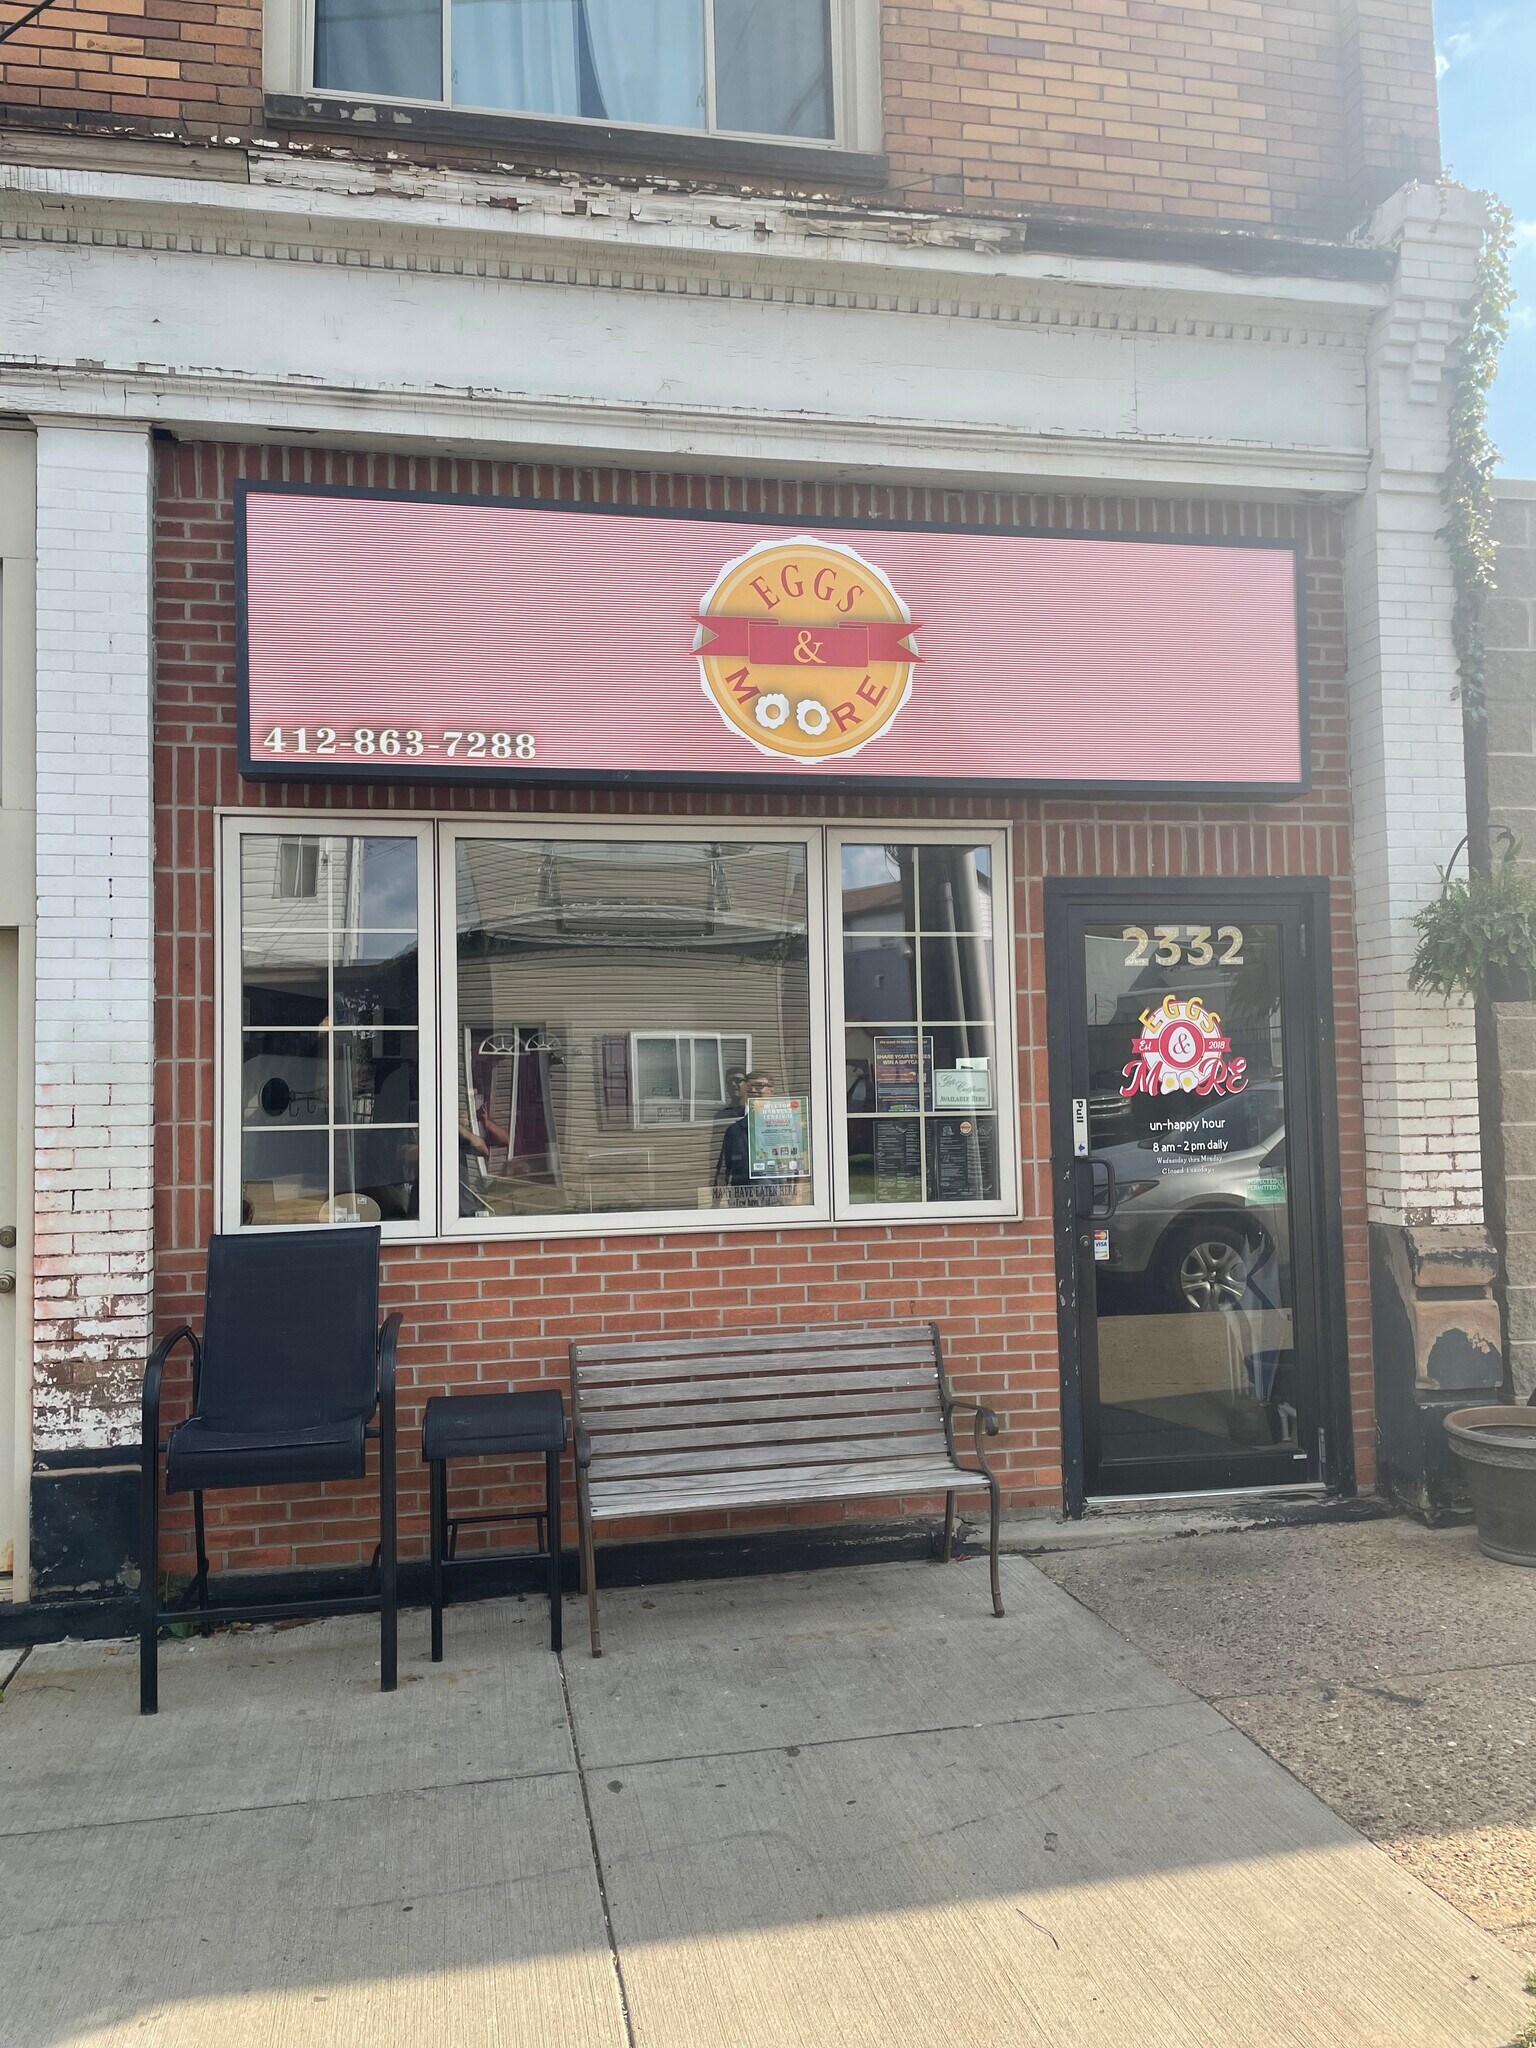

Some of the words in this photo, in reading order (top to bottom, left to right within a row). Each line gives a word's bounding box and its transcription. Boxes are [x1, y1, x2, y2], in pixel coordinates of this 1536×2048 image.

[749, 564, 864, 612] EGGS
[793, 630, 826, 664] &
[724, 666, 888, 735] MOORE
[263, 726, 536, 759] 412-863-7288
[1122, 926, 1244, 967] 2332
[1138, 994, 1221, 1034] EGGS
[1173, 1033, 1190, 1054] &
[1208, 1040, 1225, 1049] 2018
[1076, 1100, 1084, 1123] Pull
[1149, 1118, 1199, 1132] un-happy
[1201, 1117, 1226, 1129] hour
[1152, 1142, 1159, 1152] 8
[1161, 1143, 1176, 1152] am
[1183, 1140, 1190, 1151] 2
[1191, 1142, 1206, 1152] pm
[1207, 1139, 1229, 1151] daily
[1156, 1156, 1187, 1164] Wednesday
[1200, 1154, 1223, 1163] Monday
[734, 1186, 754, 1198] HAVE
[755, 1185, 778, 1197] EATEN
[779, 1184, 798, 1196] HERE
